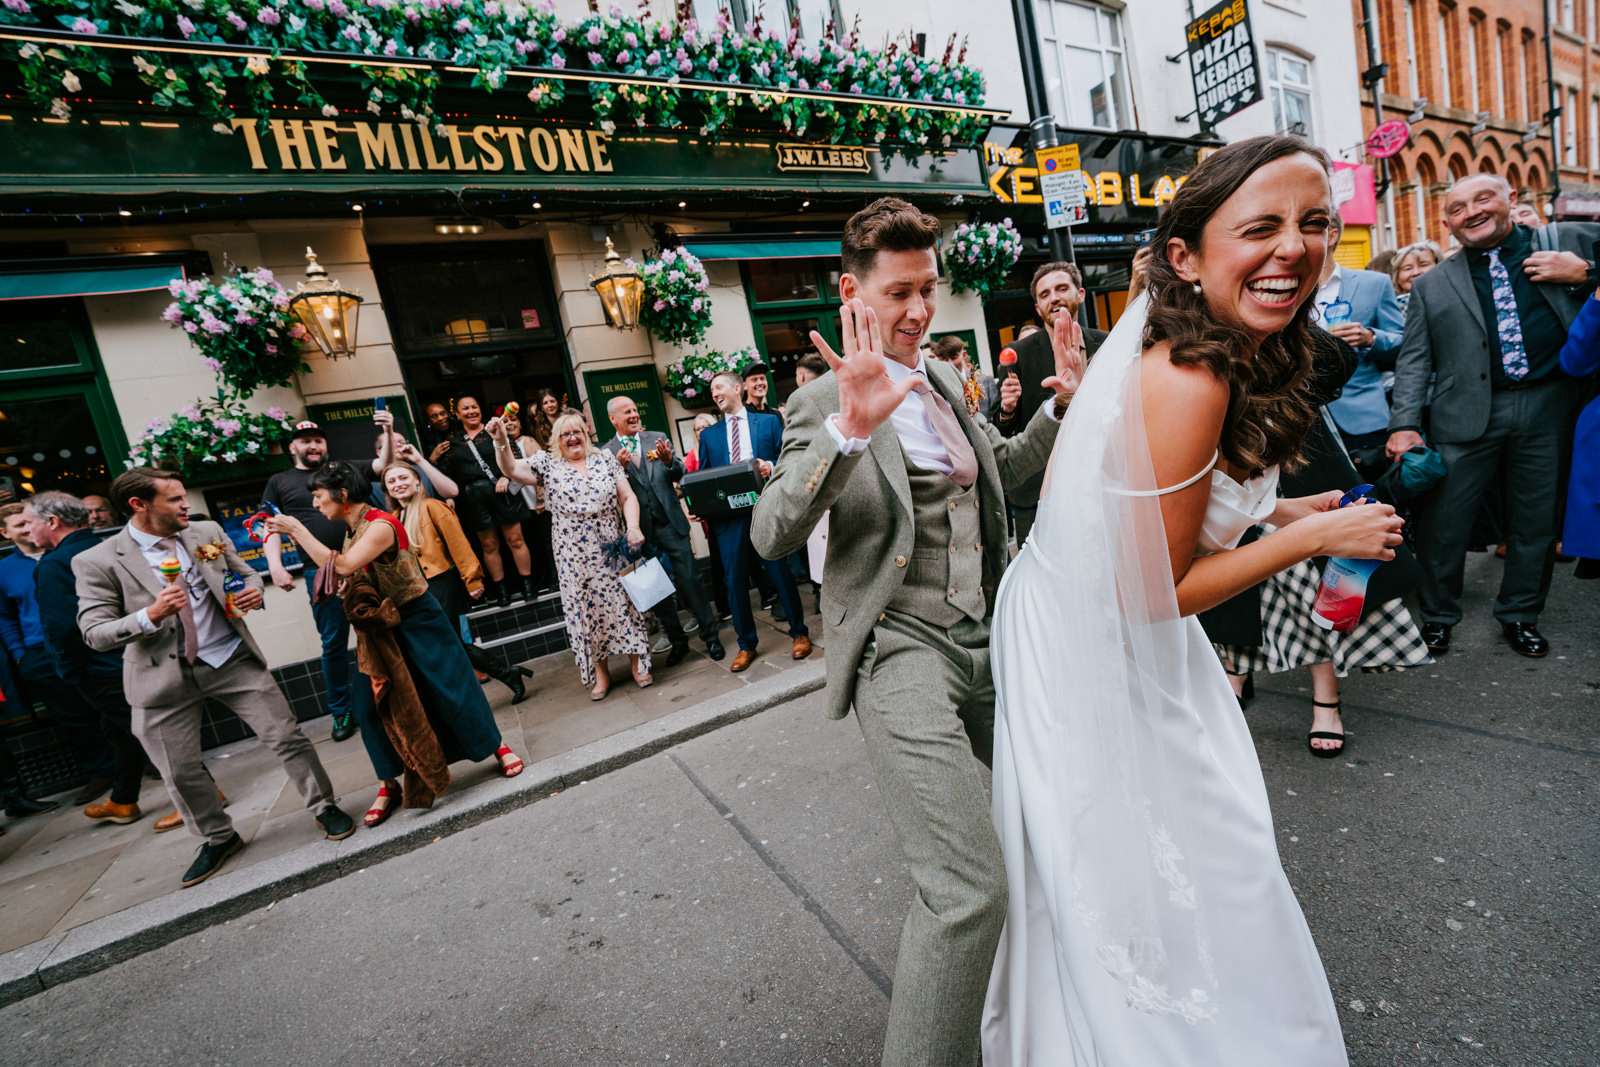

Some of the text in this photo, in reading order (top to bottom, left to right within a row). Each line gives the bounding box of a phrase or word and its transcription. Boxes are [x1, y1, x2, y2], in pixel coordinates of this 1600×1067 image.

[1187, 0, 1245, 43] KEBAB
[1210, 8, 1246, 38] LAB
[1191, 21, 1250, 76] PIZZA
[1194, 45, 1253, 96] KEBAB
[1198, 66, 1256, 114] BURGER
[230, 118, 614, 172] THE MILLSTONE
[984, 141, 1024, 165] The
[989, 166, 1190, 207] KEAB LA
[601, 381, 649, 394] THE MILLSTONE
[324, 411, 342, 421] THE
